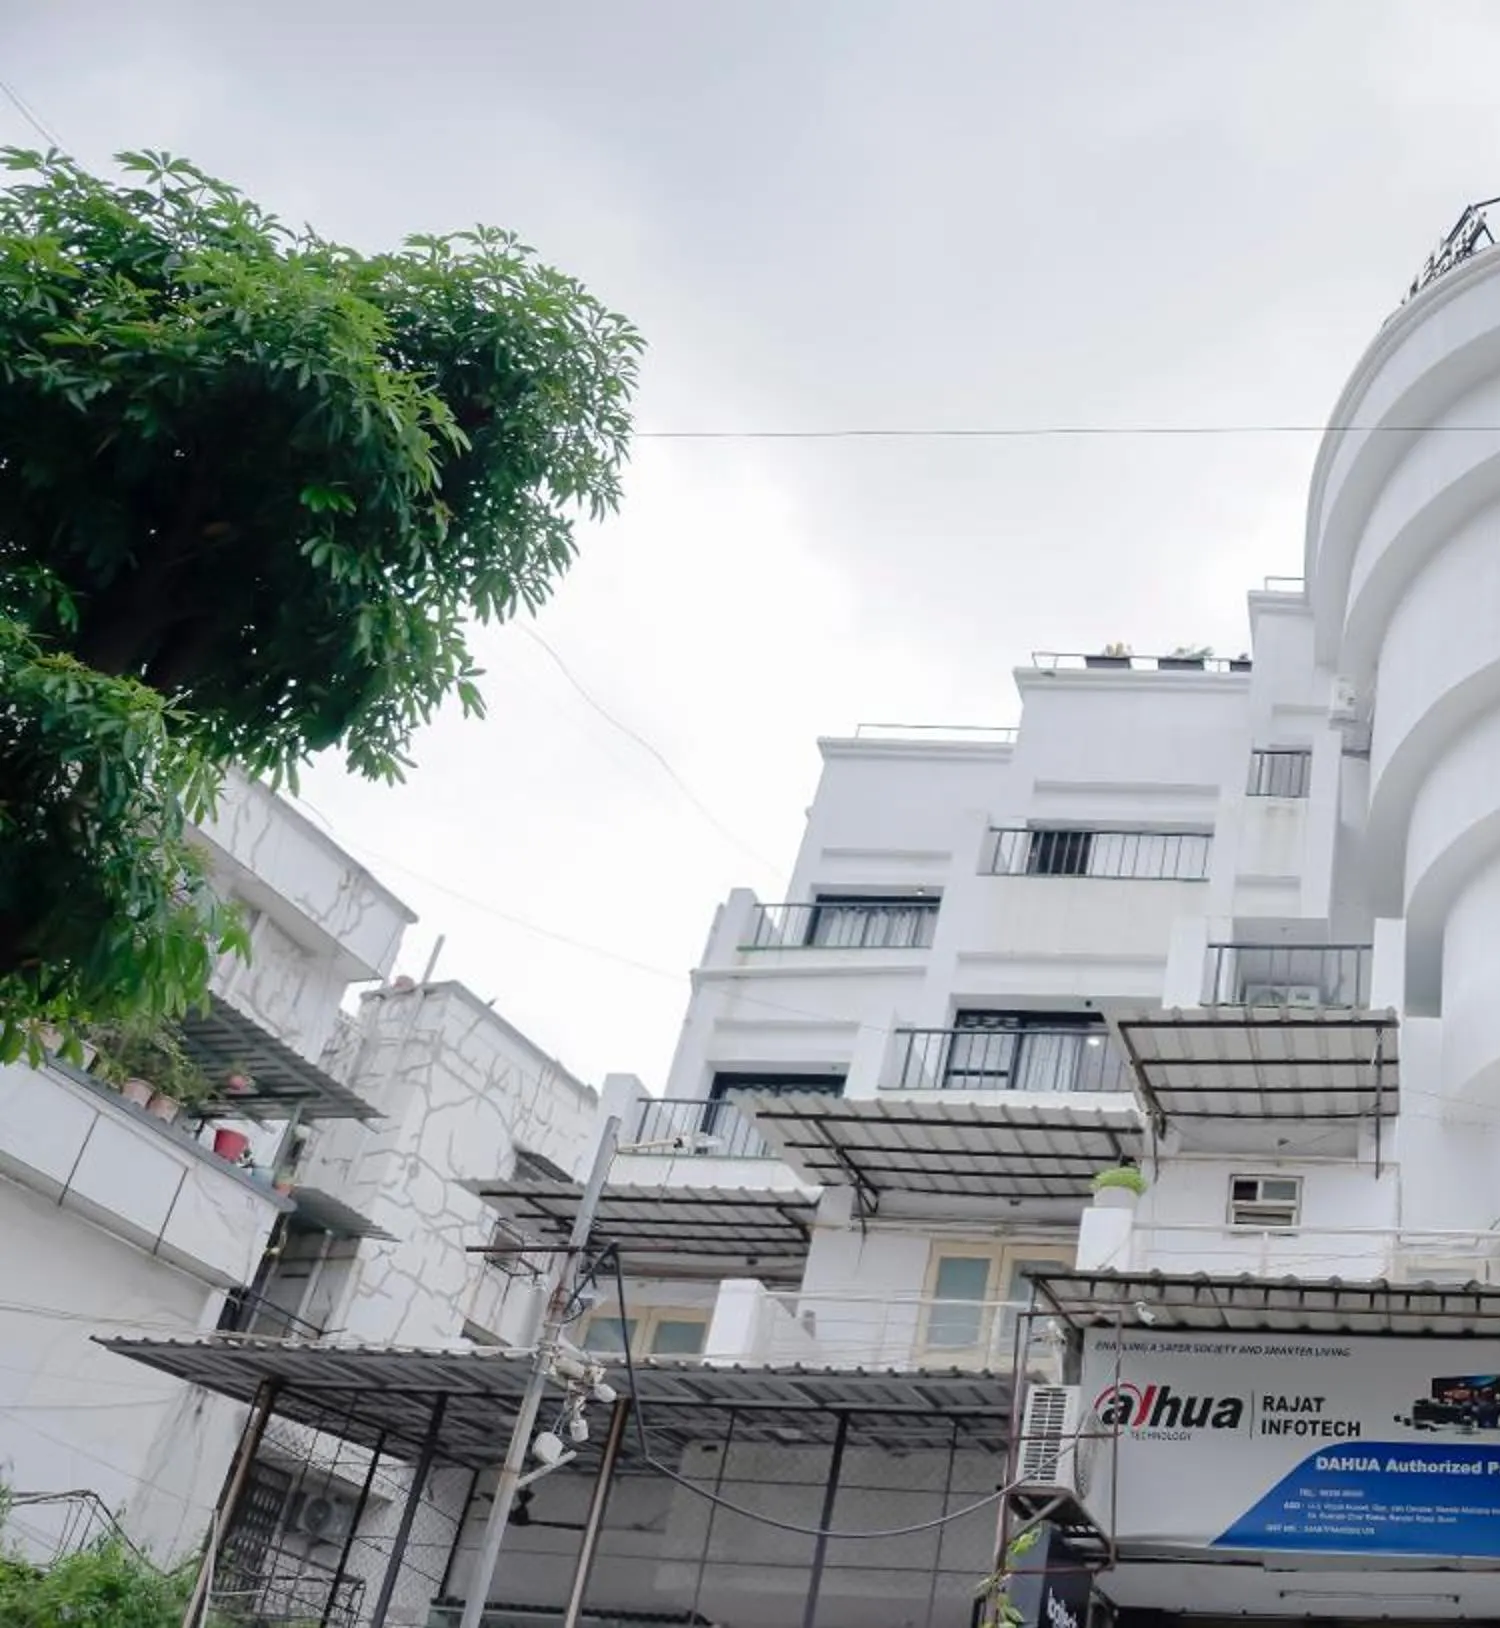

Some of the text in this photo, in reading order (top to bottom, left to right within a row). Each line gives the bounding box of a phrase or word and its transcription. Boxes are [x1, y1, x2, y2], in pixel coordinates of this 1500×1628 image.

[1193, 1344, 1237, 1355] SOCIETY
[1239, 1345, 1262, 1356] AND
[1262, 1395, 1326, 1413] RAJAT
[1261, 1419, 1361, 1438] INFOTECH
[1315, 1455, 1381, 1472] DAHUA
[1386, 1459, 1483, 1475] Authorized
